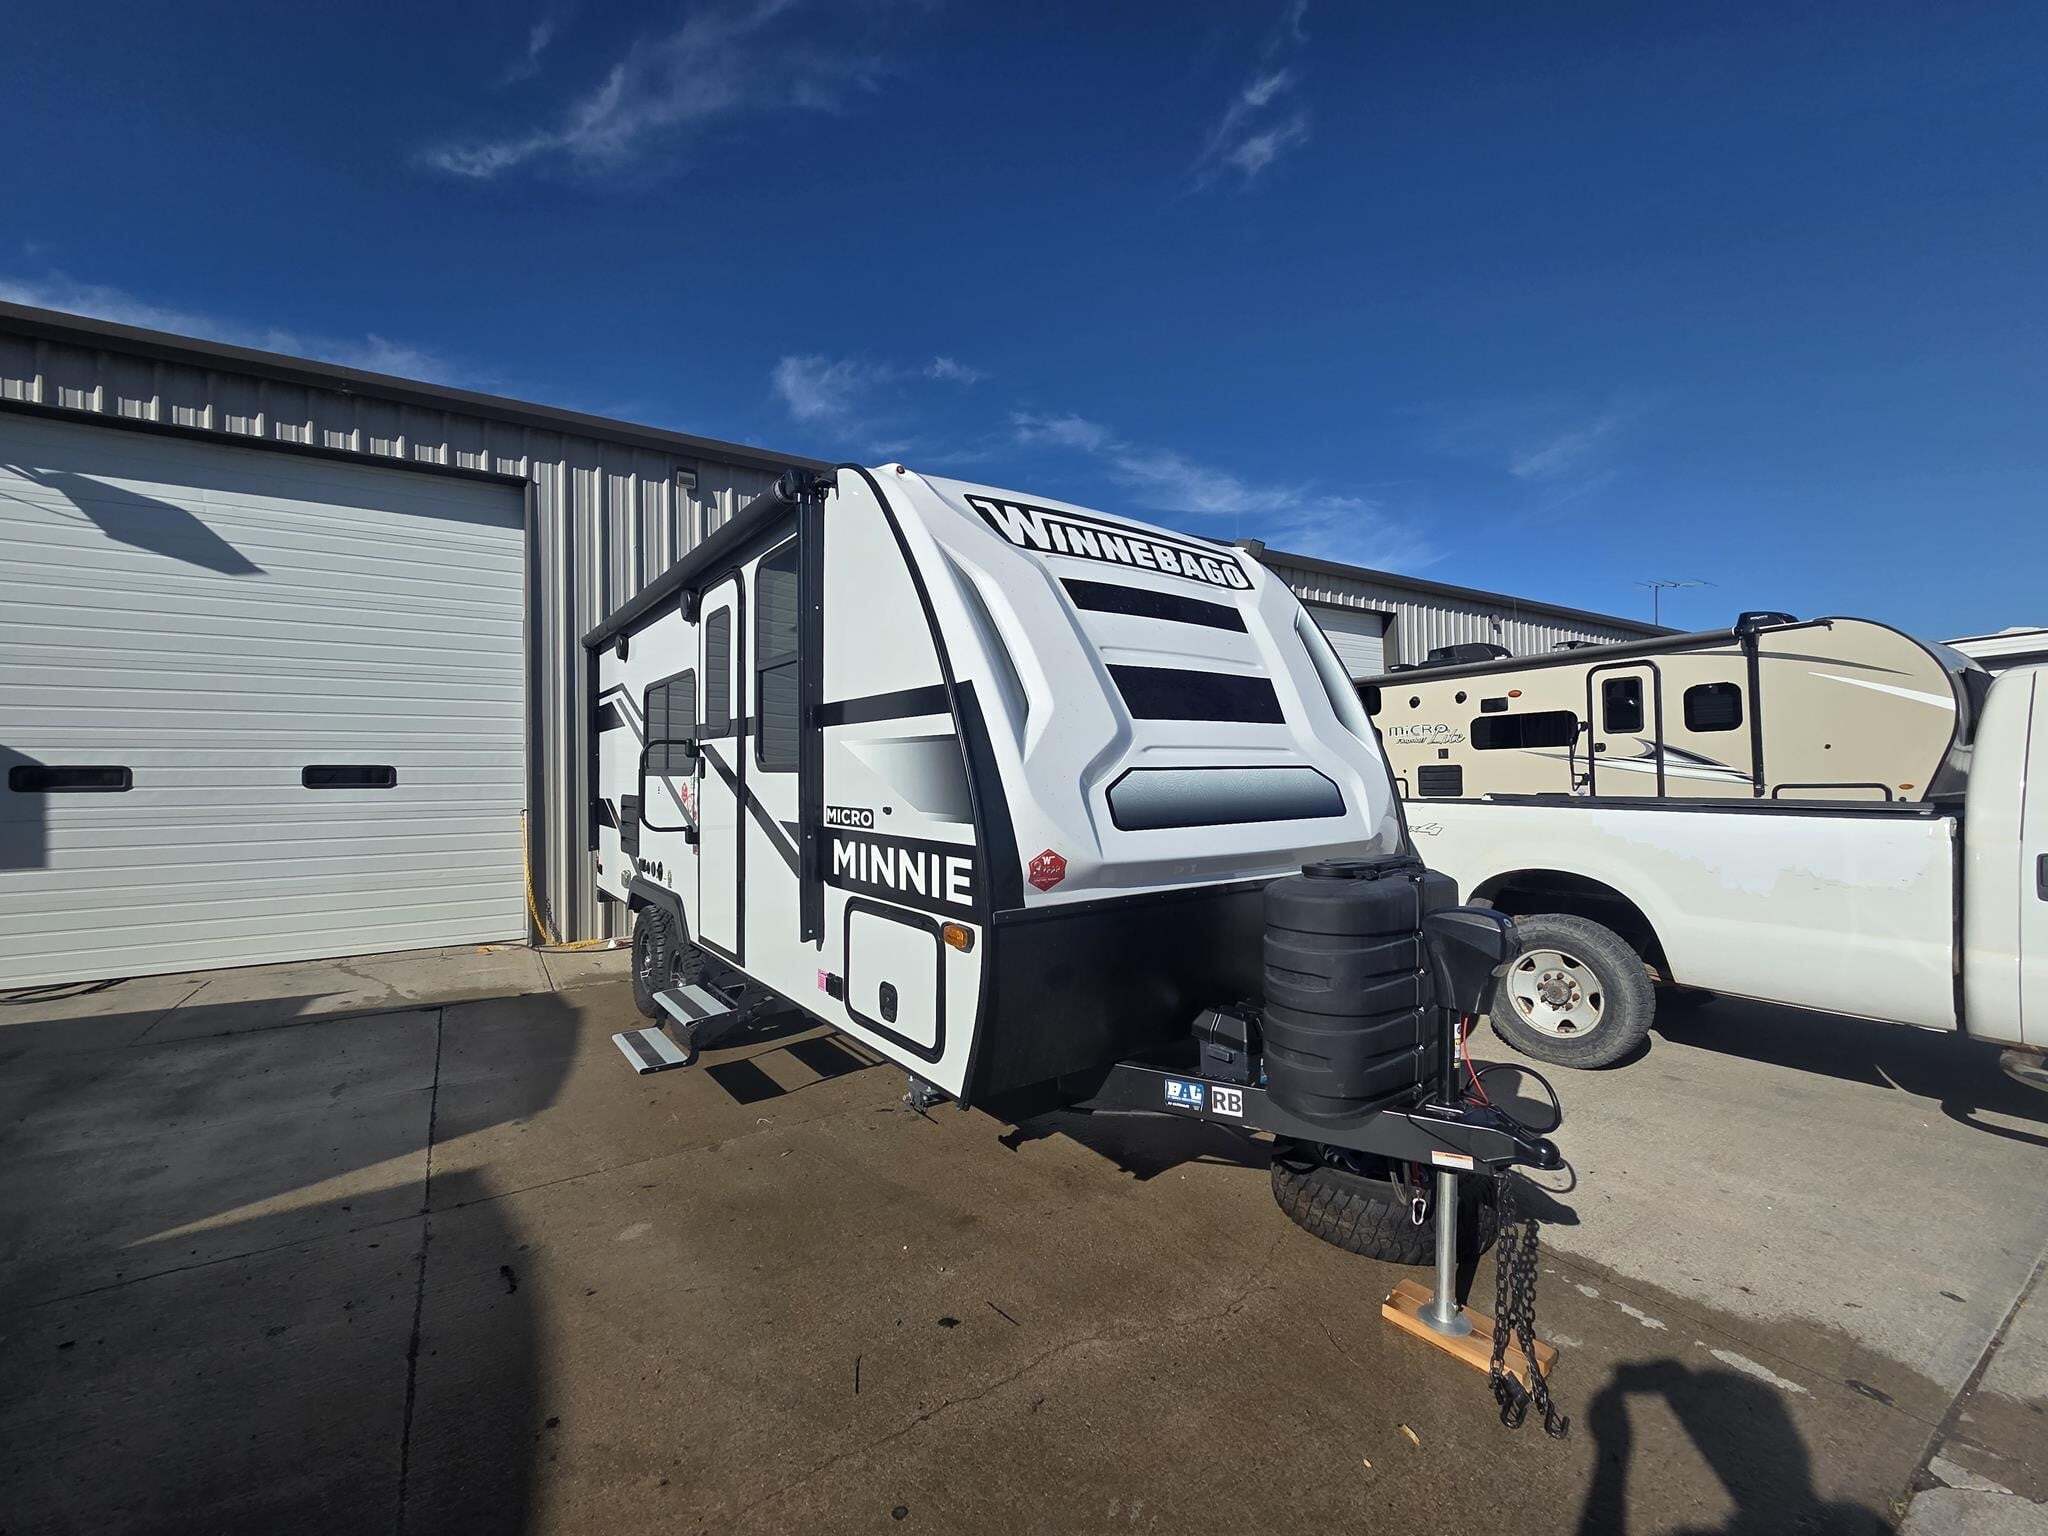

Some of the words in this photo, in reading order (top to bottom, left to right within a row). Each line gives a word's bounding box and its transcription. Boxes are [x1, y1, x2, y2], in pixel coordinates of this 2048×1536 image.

[971, 499, 1249, 589] WINNEBAGO
[826, 807, 873, 827] MICRO
[833, 838, 973, 907] MINNIE
[1212, 1090, 1242, 1113] RB
